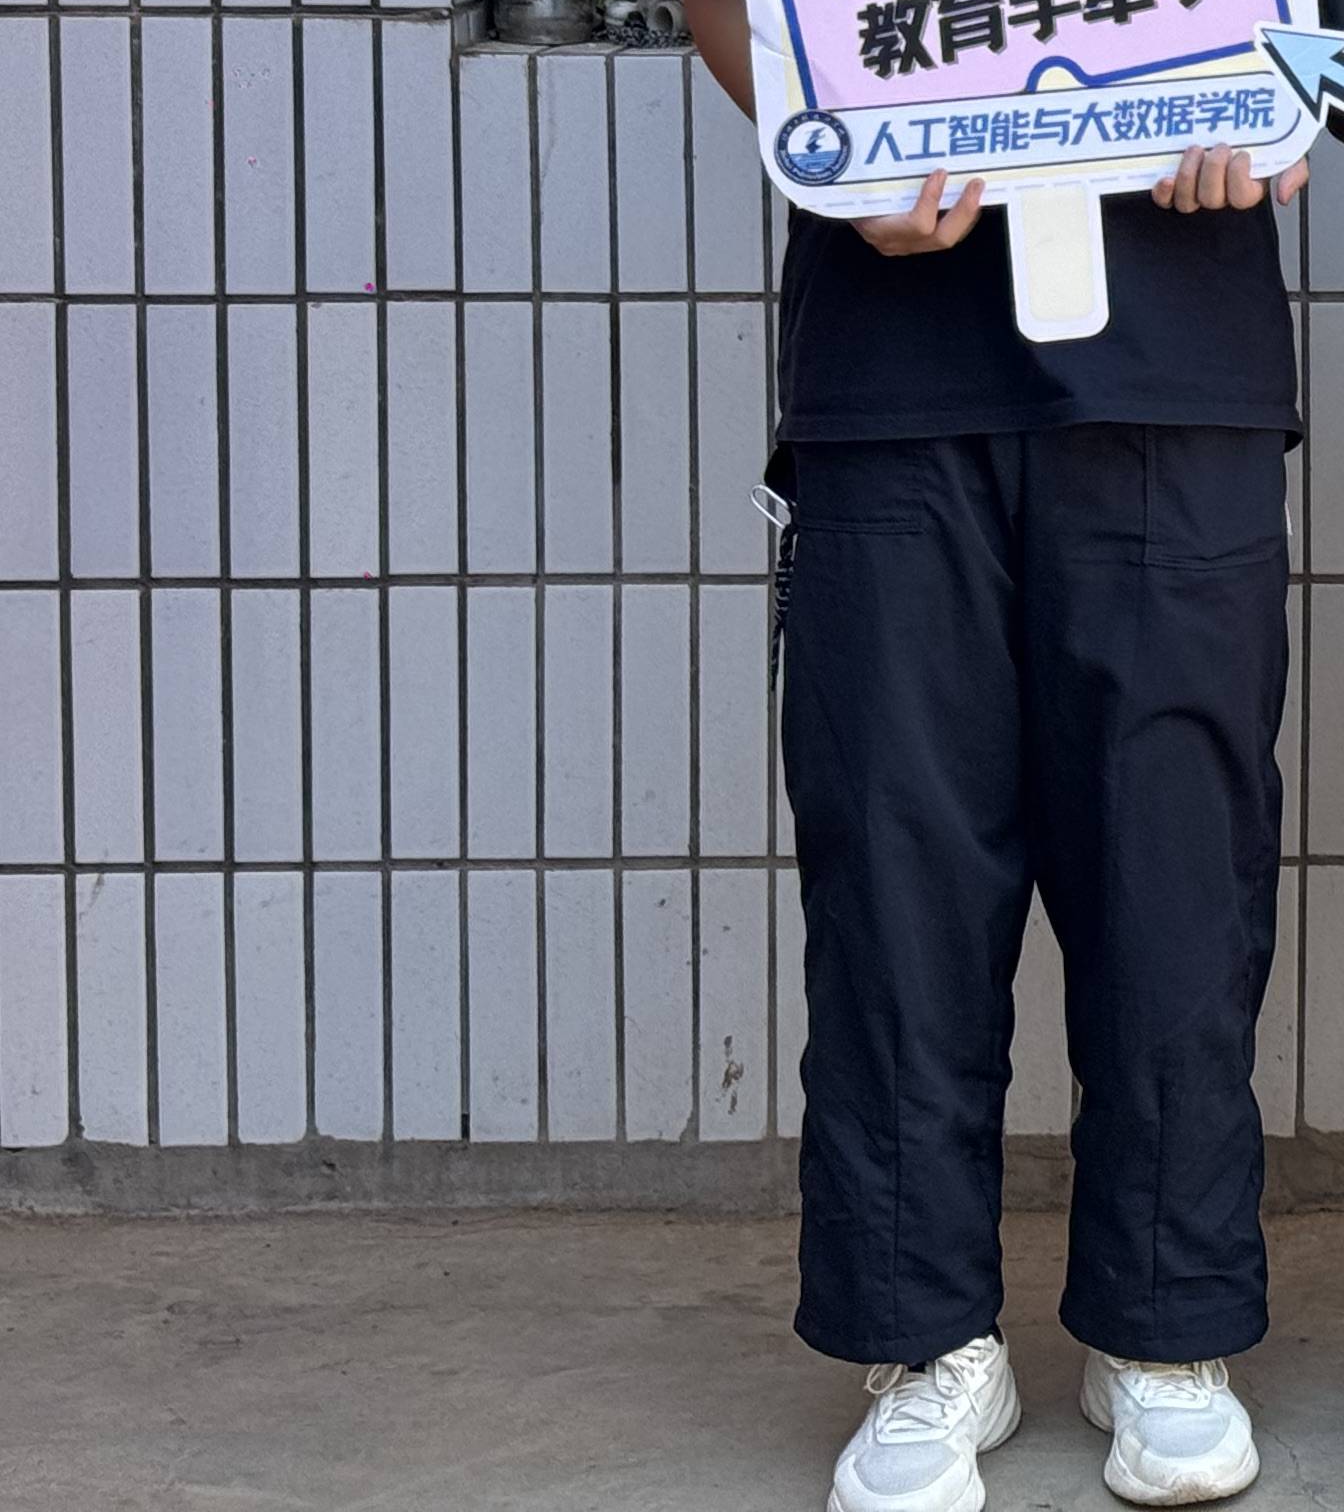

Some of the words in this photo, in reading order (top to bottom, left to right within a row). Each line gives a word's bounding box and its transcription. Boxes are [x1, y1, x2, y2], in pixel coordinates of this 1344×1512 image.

[864, 89, 1276, 165] 人工智能与大数据学院
